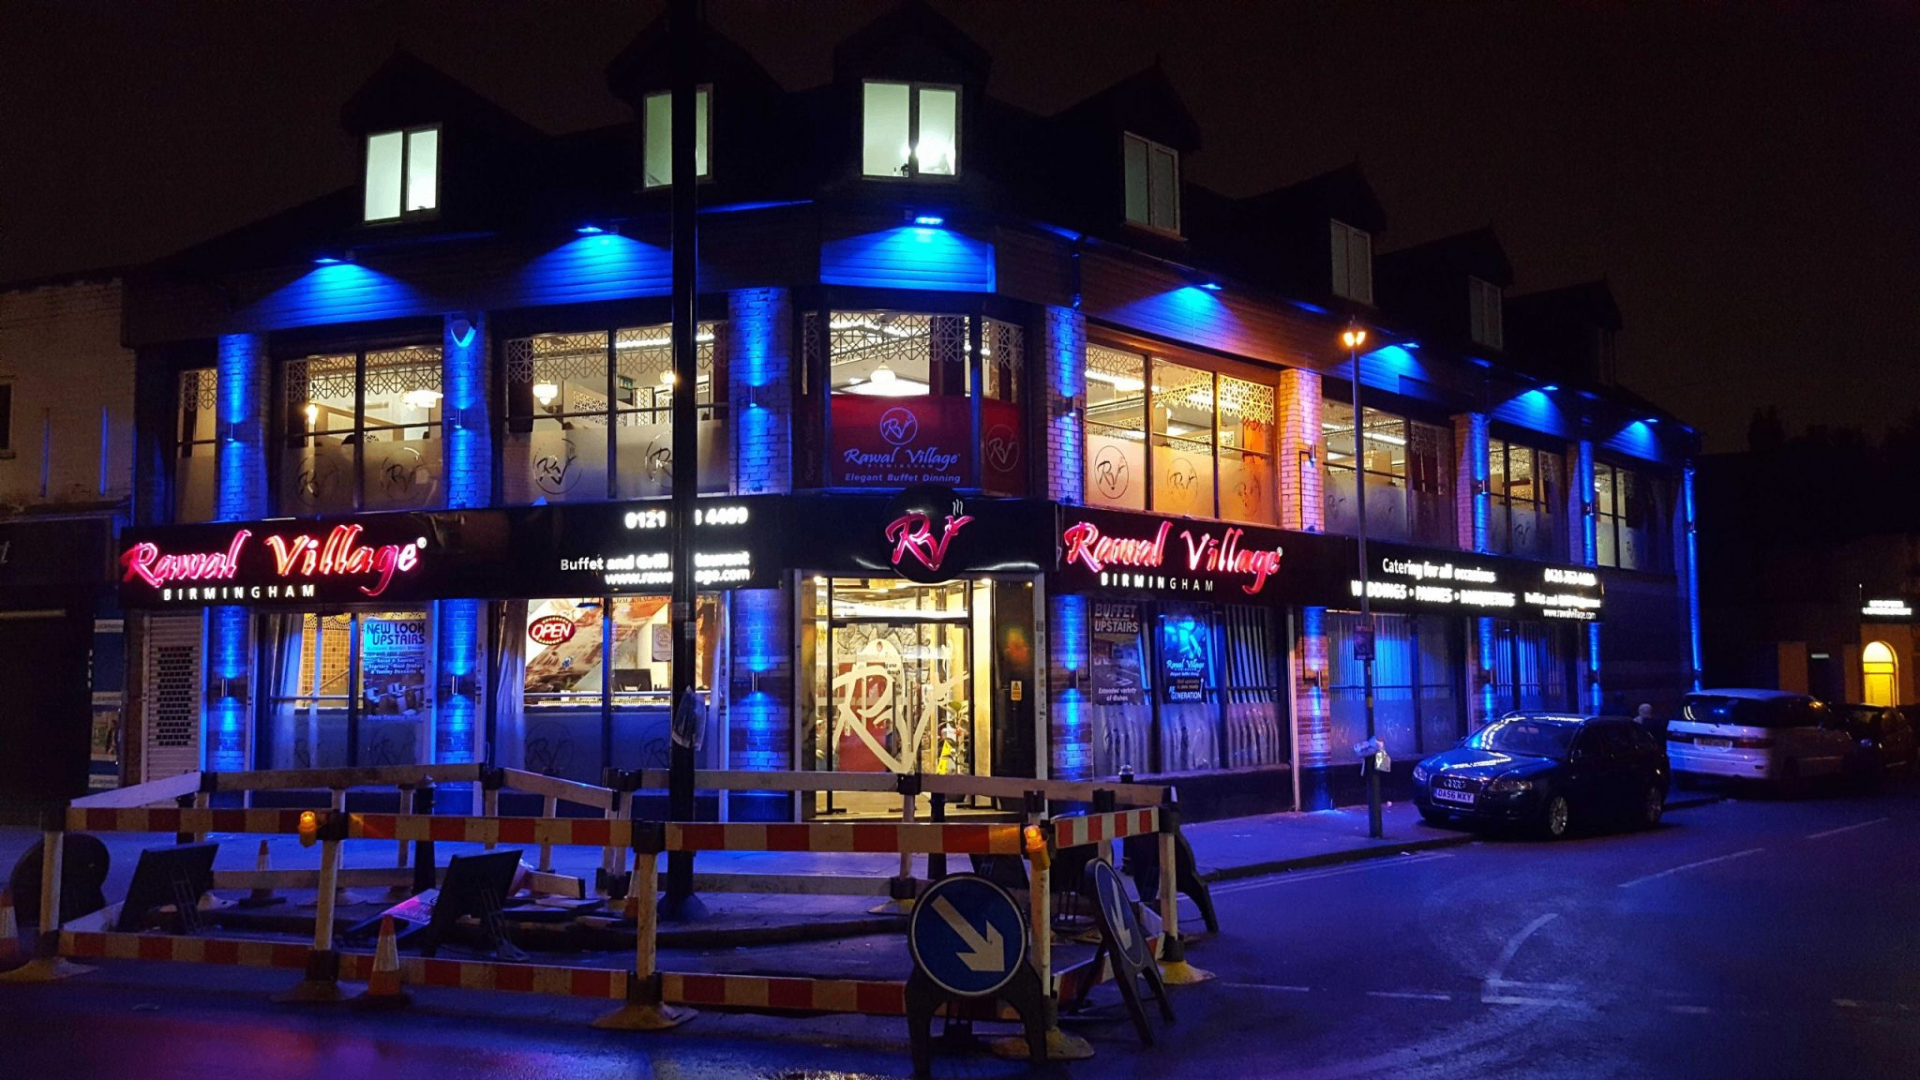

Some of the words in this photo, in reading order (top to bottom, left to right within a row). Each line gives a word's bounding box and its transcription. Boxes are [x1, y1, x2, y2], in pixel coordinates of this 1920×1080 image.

[883, 416, 915, 439] RV
[844, 447, 899, 465] Rawal
[905, 447, 960, 471] Village
[845, 473, 883, 483] Elegant
[887, 473, 918, 483] Buffet
[922, 473, 961, 484] Dinning
[625, 510, 667, 529] 0121
[885, 511, 975, 571] RV
[121, 529, 252, 588] Rawal
[264, 524, 420, 596] Village
[560, 556, 604, 571] Buffet
[606, 554, 635, 571] and
[1063, 521, 1173, 572] Rawal
[1180, 527, 1280, 594] Village
[1382, 558, 1423, 580] Catering
[1423, 561, 1439, 578] for
[1439, 563, 1453, 579] all
[1100, 572, 1214, 592] BIRMINGHAM
[1351, 580, 1407, 600] WDDINGS
[163, 584, 316, 601] BIRMINGHAM
[1094, 604, 1137, 618] BUFFET
[366, 623, 391, 634] NEW
[394, 623, 425, 634] LOOK
[531, 622, 572, 639] OPEN
[1094, 619, 1139, 633] UPSTAIRS
[372, 633, 425, 645] UPSTAIRS
[1098, 687, 1119, 695] Extended
[1120, 687, 1137, 696] variety
[1170, 691, 1201, 700] GENERATION
